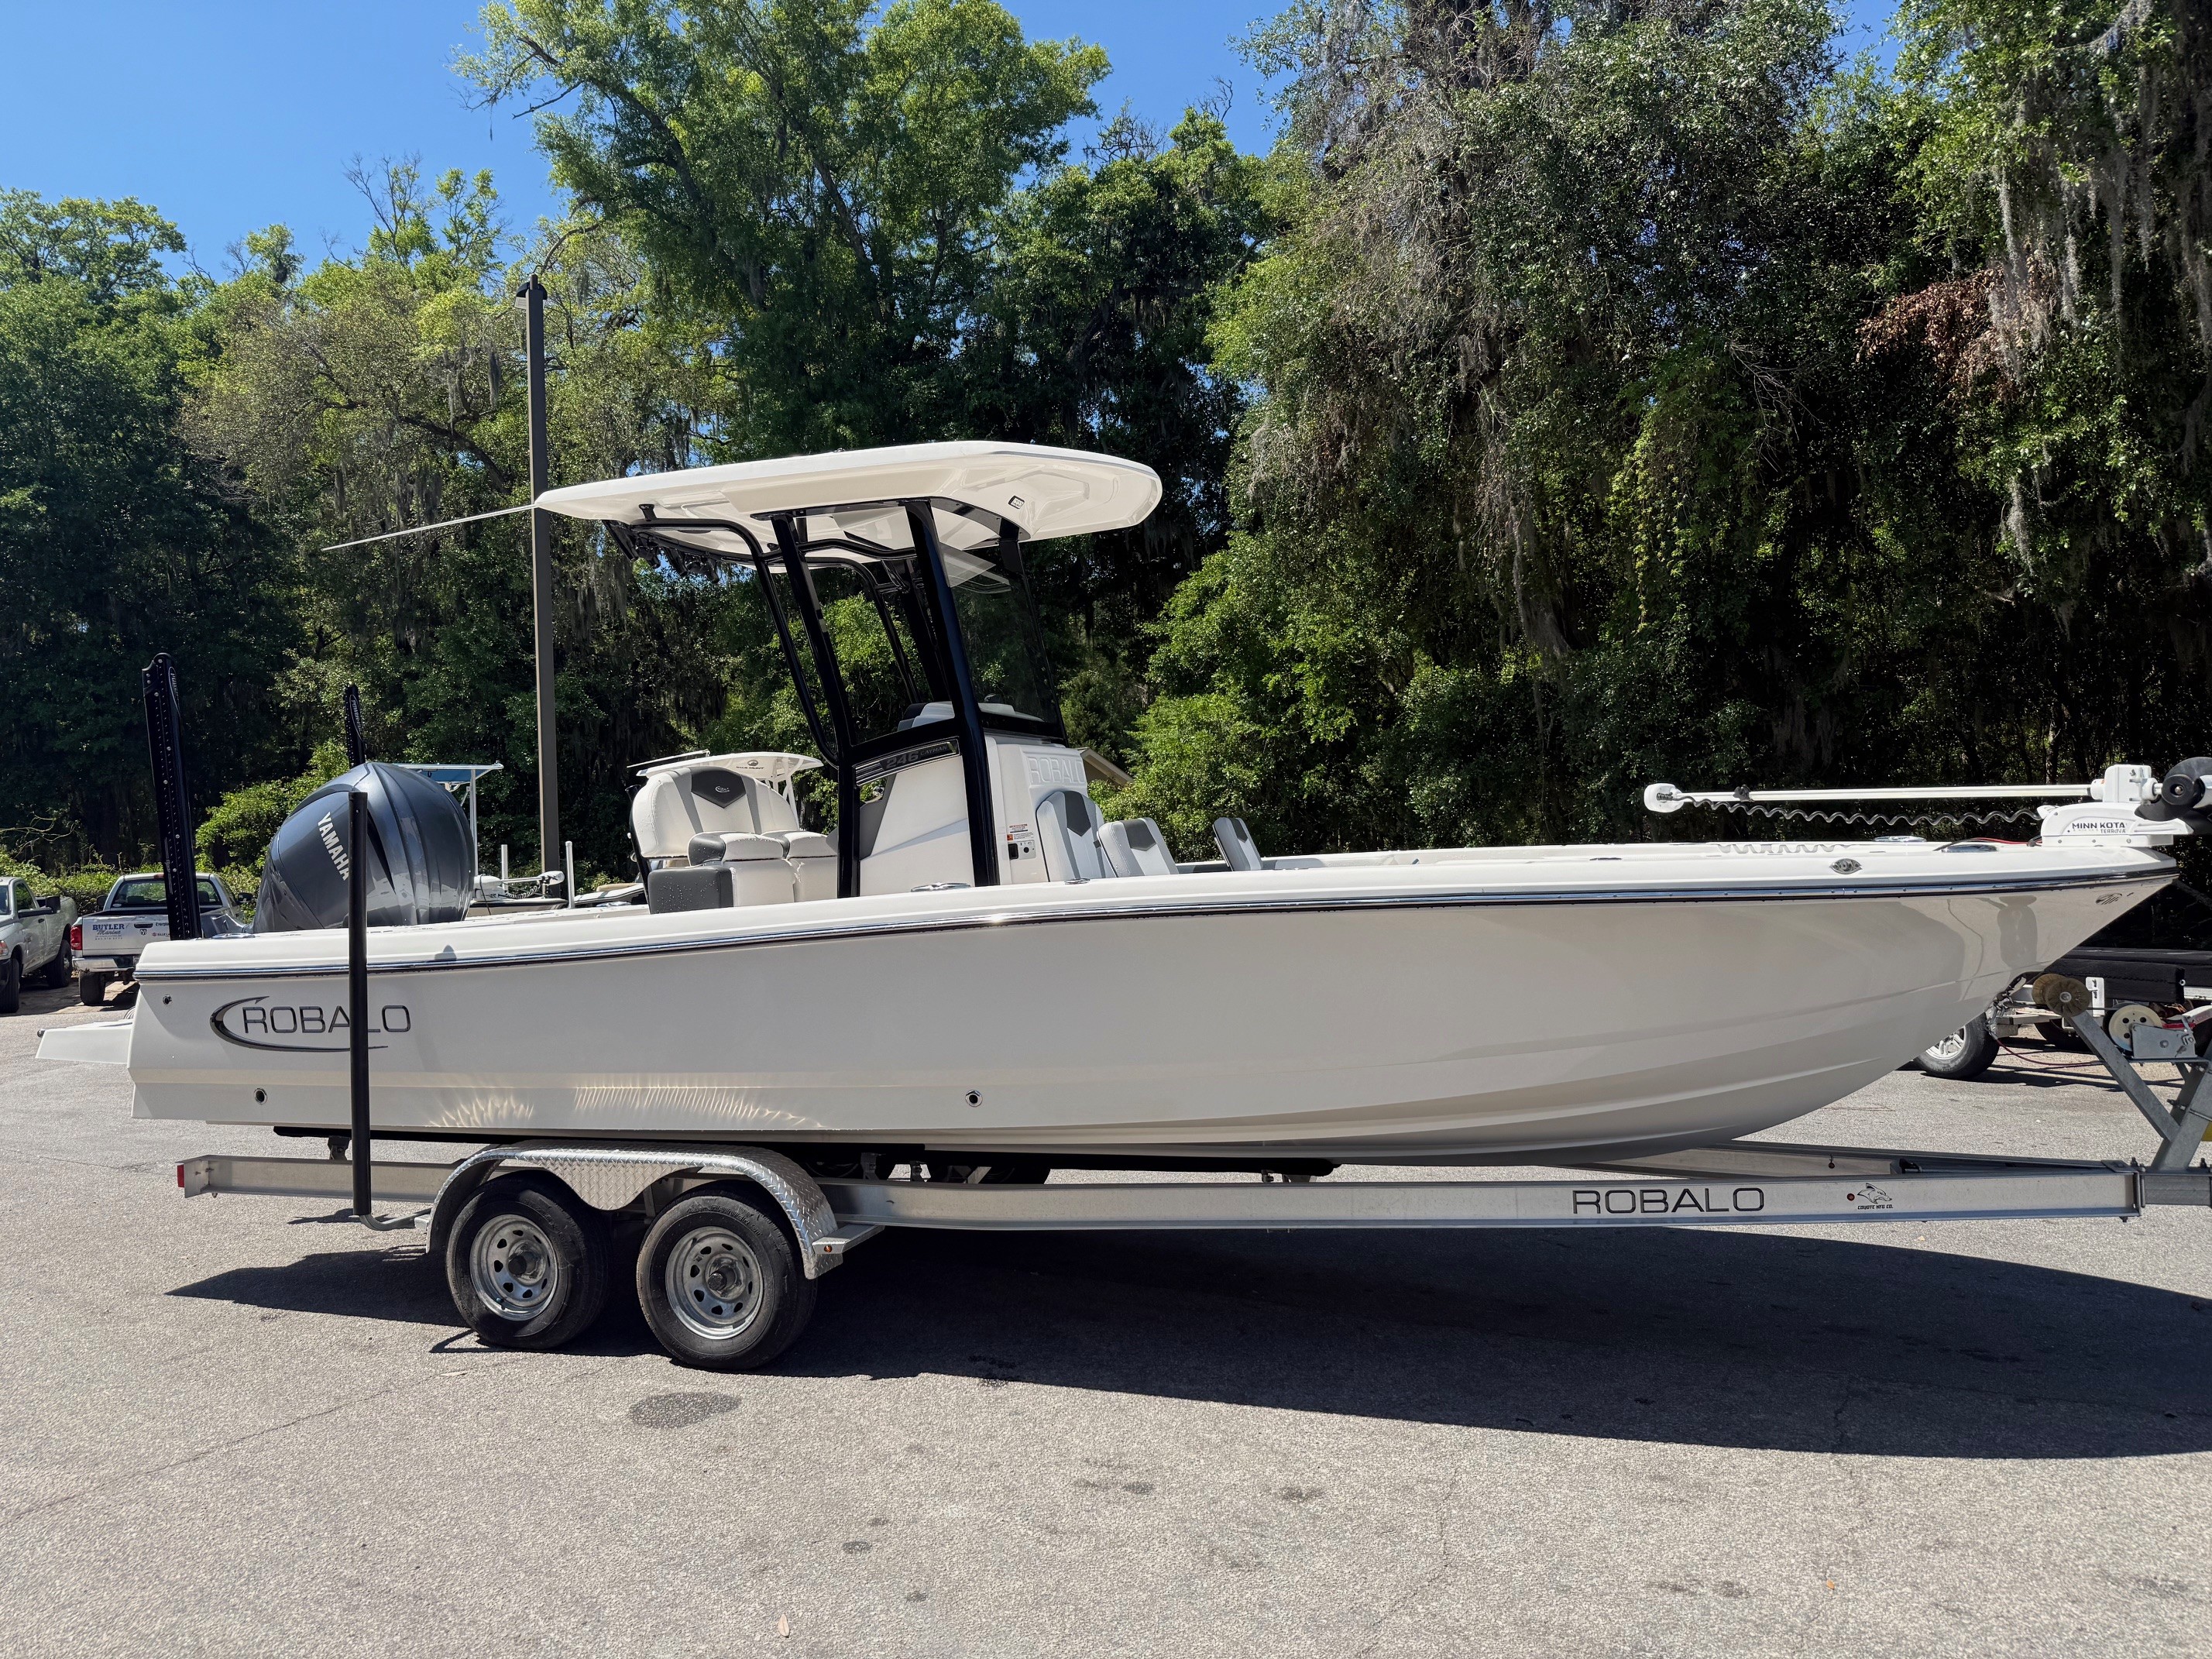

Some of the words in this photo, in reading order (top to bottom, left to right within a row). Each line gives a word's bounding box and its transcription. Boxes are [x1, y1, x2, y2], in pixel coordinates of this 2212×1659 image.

[886, 751, 919, 768] 246
[920, 746, 947, 756] CAYMAN
[1029, 757, 1085, 783] ROBALO
[1572, 1187, 1764, 1214] ROBALO
